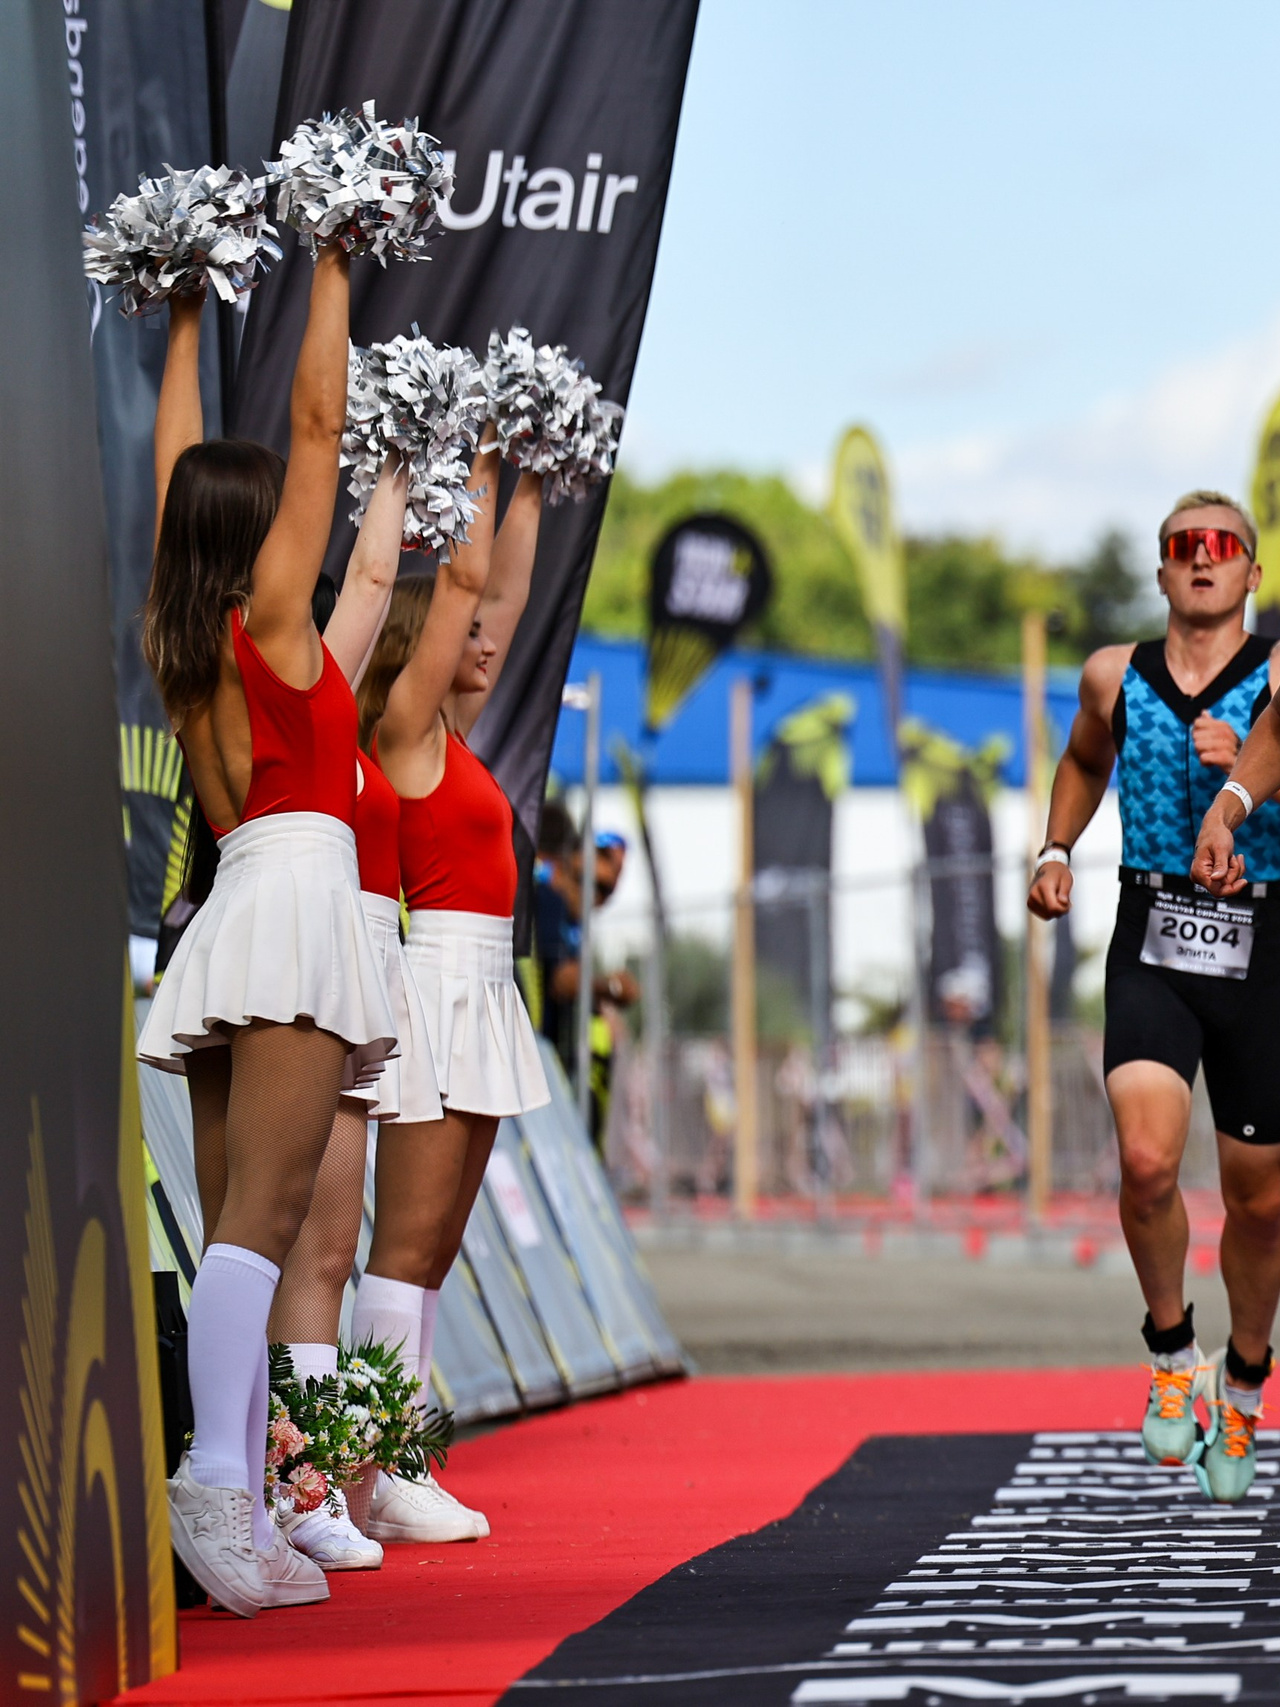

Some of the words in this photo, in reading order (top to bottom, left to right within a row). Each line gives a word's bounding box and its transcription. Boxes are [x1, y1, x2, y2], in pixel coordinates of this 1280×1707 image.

[434, 149, 639, 234] Utair
[1160, 916, 1240, 949] 2004
[1176, 946, 1216, 961] ЭЛИТА
